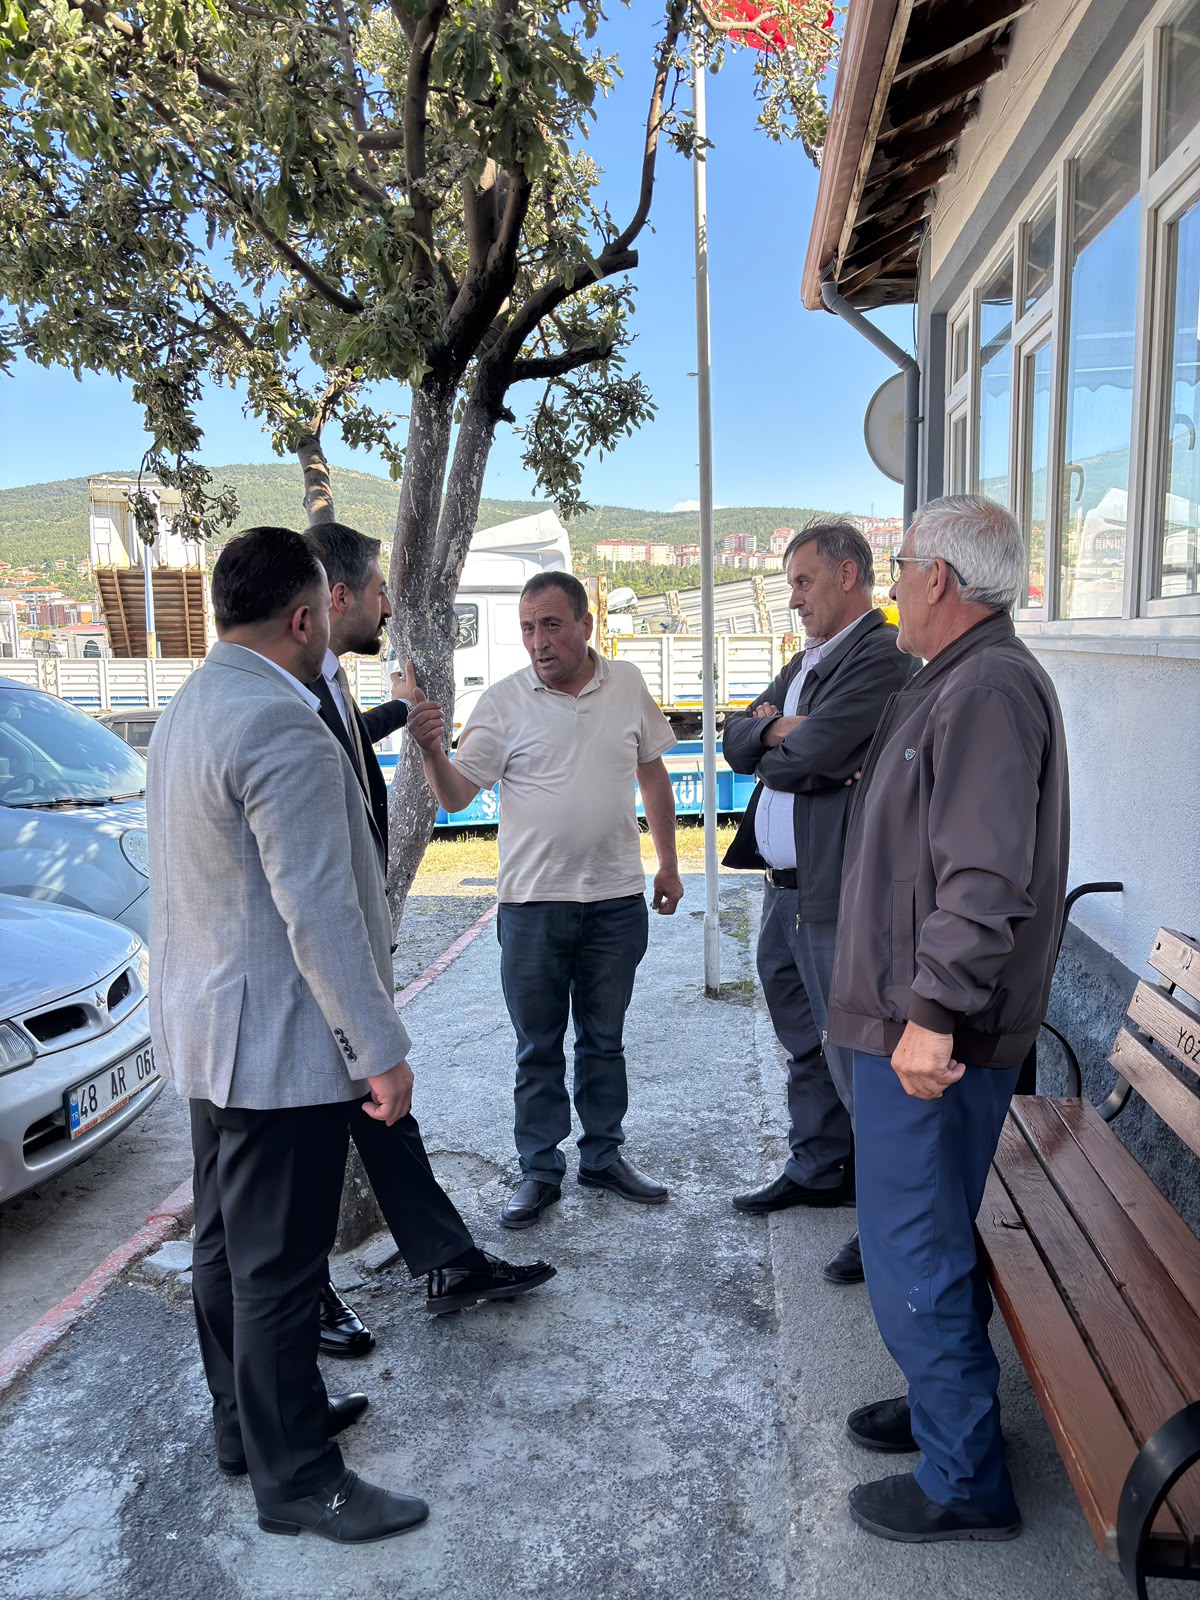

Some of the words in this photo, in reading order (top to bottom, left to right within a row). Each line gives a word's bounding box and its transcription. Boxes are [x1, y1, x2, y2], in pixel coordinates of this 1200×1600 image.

[80, 1083, 98, 1118] 48
[111, 1065, 127, 1100] AR
[71, 1111, 79, 1121] TR
